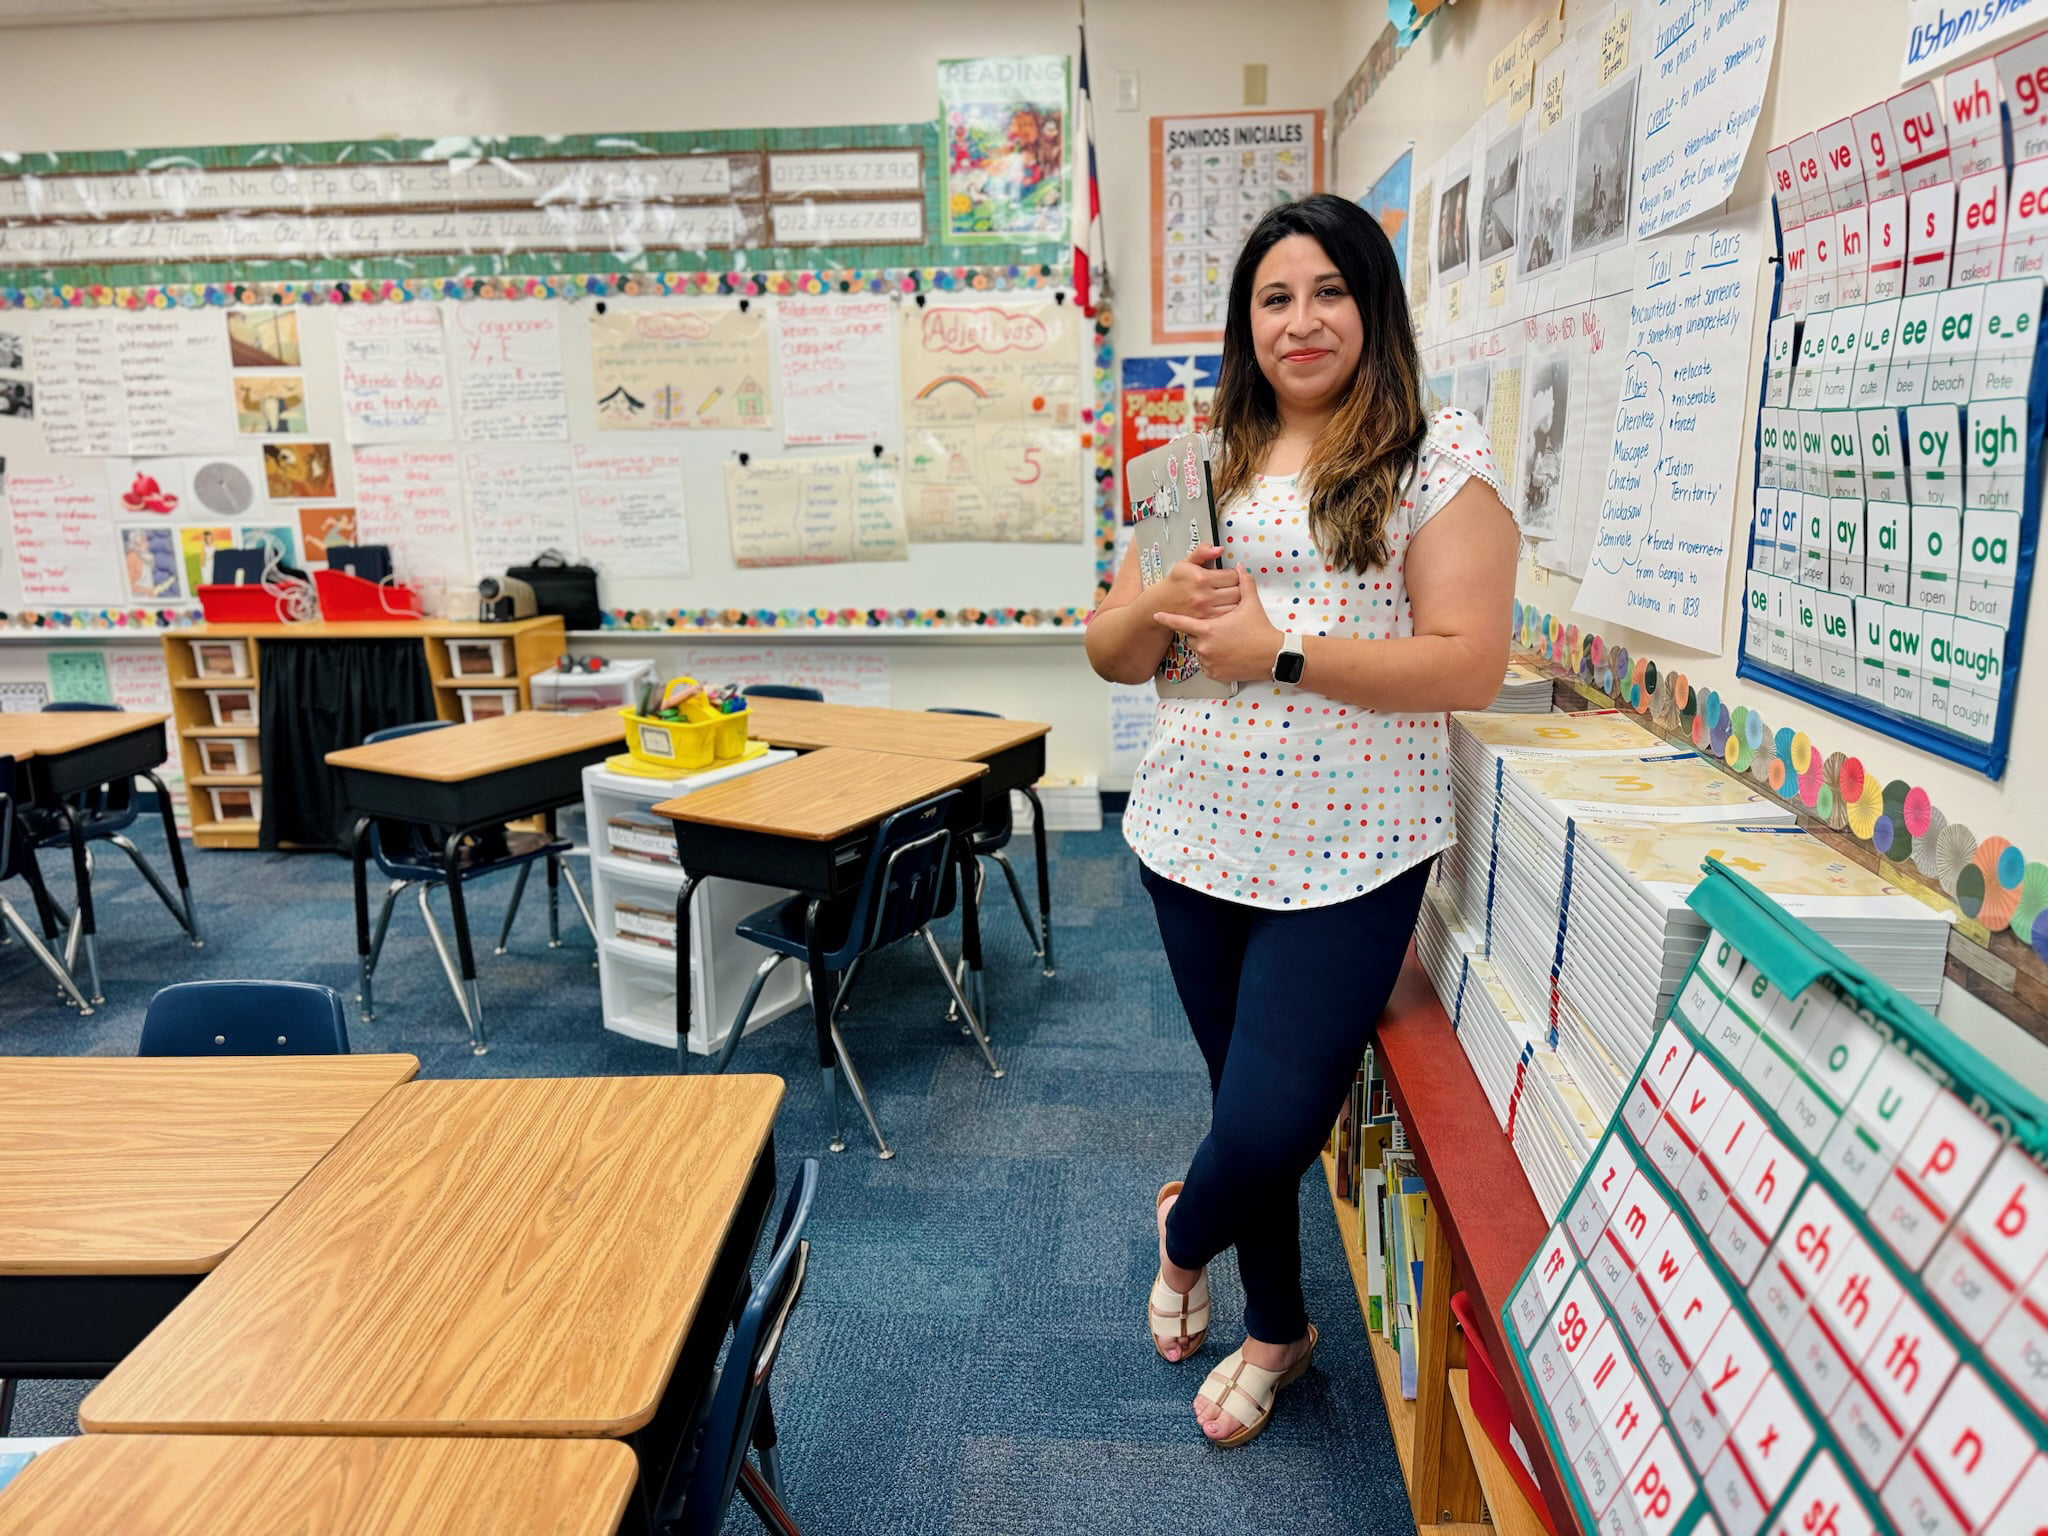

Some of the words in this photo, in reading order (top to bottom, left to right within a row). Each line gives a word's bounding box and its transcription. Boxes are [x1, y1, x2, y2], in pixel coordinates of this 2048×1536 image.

[1676, 40, 1698, 76] place
[1692, 65, 1718, 97] make
[1723, 35, 1766, 74] something
[946, 62, 1063, 84] READING
[1953, 79, 1991, 124] wh
[1169, 128, 1231, 150] SONIDOS
[1234, 124, 1304, 146] INICIALES
[1903, 111, 1935, 153] qu
[1828, 145, 1851, 171] ve
[1870, 132, 1886, 167] g
[1800, 158, 1818, 182] ce
[1962, 156, 1992, 175] when
[1777, 169, 1792, 192] se
[1966, 184, 1997, 229] ed
[1883, 222, 1891, 248] s
[1925, 212, 1935, 238] s
[1817, 240, 1827, 262] c
[1843, 224, 1860, 256] kn
[1648, 251, 1672, 281] Trail
[1685, 234, 1699, 268] of
[1709, 228, 1741, 258] Tears
[1788, 247, 1806, 272] wr
[2014, 252, 2045, 274] filled
[1918, 274, 1935, 289] sun
[1961, 260, 1993, 283] asked
[1875, 279, 1894, 297] dogs
[1632, 293, 1677, 325] encountered
[1684, 284, 1702, 309] met
[1704, 281, 1741, 306] someone
[929, 313, 1036, 346] Adjetivos
[1647, 322, 1682, 346] something
[1687, 306, 1741, 339] unexpectedly
[1903, 320, 1928, 346] ee
[1942, 312, 1973, 342] ea
[1988, 312, 2030, 338] e_e
[1773, 339, 1788, 361] i_e
[1803, 337, 1825, 358] a_e
[1831, 332, 1856, 355] o_e
[1864, 328, 1890, 351] u_e
[1625, 364, 1648, 396] Tribes
[1679, 357, 1712, 382] relocate
[1986, 372, 2013, 390] Pete
[1676, 385, 1717, 406] miserable
[1825, 381, 1845, 396] home
[1860, 381, 1878, 395] cute
[1896, 378, 1914, 393] bee
[1932, 376, 1965, 392] beach
[1616, 407, 1655, 433] Cherokee
[1674, 411, 1697, 432] forced
[1764, 428, 1777, 448] oo
[1783, 430, 1797, 451] oo
[1803, 432, 1821, 454] ow
[1831, 433, 1854, 457] ou
[1872, 425, 1891, 456] oi
[1919, 431, 1949, 468] oy
[1975, 415, 2017, 467] igh
[1613, 438, 1649, 468] Muscogee
[1013, 448, 1042, 485] 5
[1603, 499, 1643, 521] Chickasaw
[1928, 489, 1945, 506] toy
[1979, 490, 2009, 508] night
[1760, 507, 1772, 528] ar
[1782, 510, 1797, 532] or
[1811, 517, 1821, 539] a
[1597, 526, 1632, 547] Seminole
[1652, 529, 1675, 551] forced
[1679, 537, 1723, 557] movement
[1837, 520, 1857, 555] ay
[1879, 519, 1897, 550] ai
[1927, 531, 1943, 557] o
[1971, 536, 2007, 565] oa
[1636, 559, 1654, 581] from
[1659, 563, 1684, 588] Georgia
[1690, 571, 1698, 585] to
[1804, 567, 1824, 582] paper
[1840, 573, 1854, 590] day
[1751, 590, 1767, 612] oe
[1877, 581, 1896, 596] wait
[1919, 590, 1946, 608] open
[1627, 590, 1661, 613] Oklahoma
[1669, 597, 1676, 614] in
[1683, 596, 1701, 619] 1838
[1799, 599, 1814, 628] ie
[1969, 595, 1997, 615] boat
[1824, 613, 1847, 638] ue
[1869, 622, 1880, 646] u
[1889, 628, 1920, 656] aw
[1831, 662, 1846, 679] cue
[1954, 647, 1999, 681] augh
[1866, 676, 1881, 691] unit
[1893, 684, 1913, 701] paw
[1952, 703, 1990, 728] caught
[1691, 988, 1706, 1010] hat
[1720, 1025, 1742, 1047] pet
[1658, 1045, 1677, 1076] f
[1690, 1088, 1707, 1115] v
[1877, 1085, 1904, 1124] u
[1663, 1140, 1679, 1162] vet
[1919, 1136, 1958, 1181] p
[1755, 1157, 1778, 1205] h
[1624, 1203, 1648, 1240] m
[1994, 1181, 2028, 1239] b
[1795, 1223, 1831, 1275] ch
[1543, 1248, 1566, 1284] ff
[1600, 1255, 1621, 1283] mad
[1658, 1249, 1680, 1284] w
[1683, 1297, 1703, 1321] r
[1838, 1273, 1871, 1329] th
[1558, 1301, 1588, 1353] gg
[1631, 1301, 1648, 1329] wet
[1542, 1353, 1556, 1383] egg
[1654, 1348, 1674, 1377] red
[1712, 1353, 1741, 1392] y
[1885, 1333, 1921, 1396] th
[1565, 1402, 1582, 1434] bell
[1615, 1401, 1640, 1441] tt
[1757, 1424, 1780, 1460] x
[1952, 1426, 1984, 1476] n
[1584, 1450, 1607, 1497] sitting
[1633, 1460, 1671, 1519] pp
